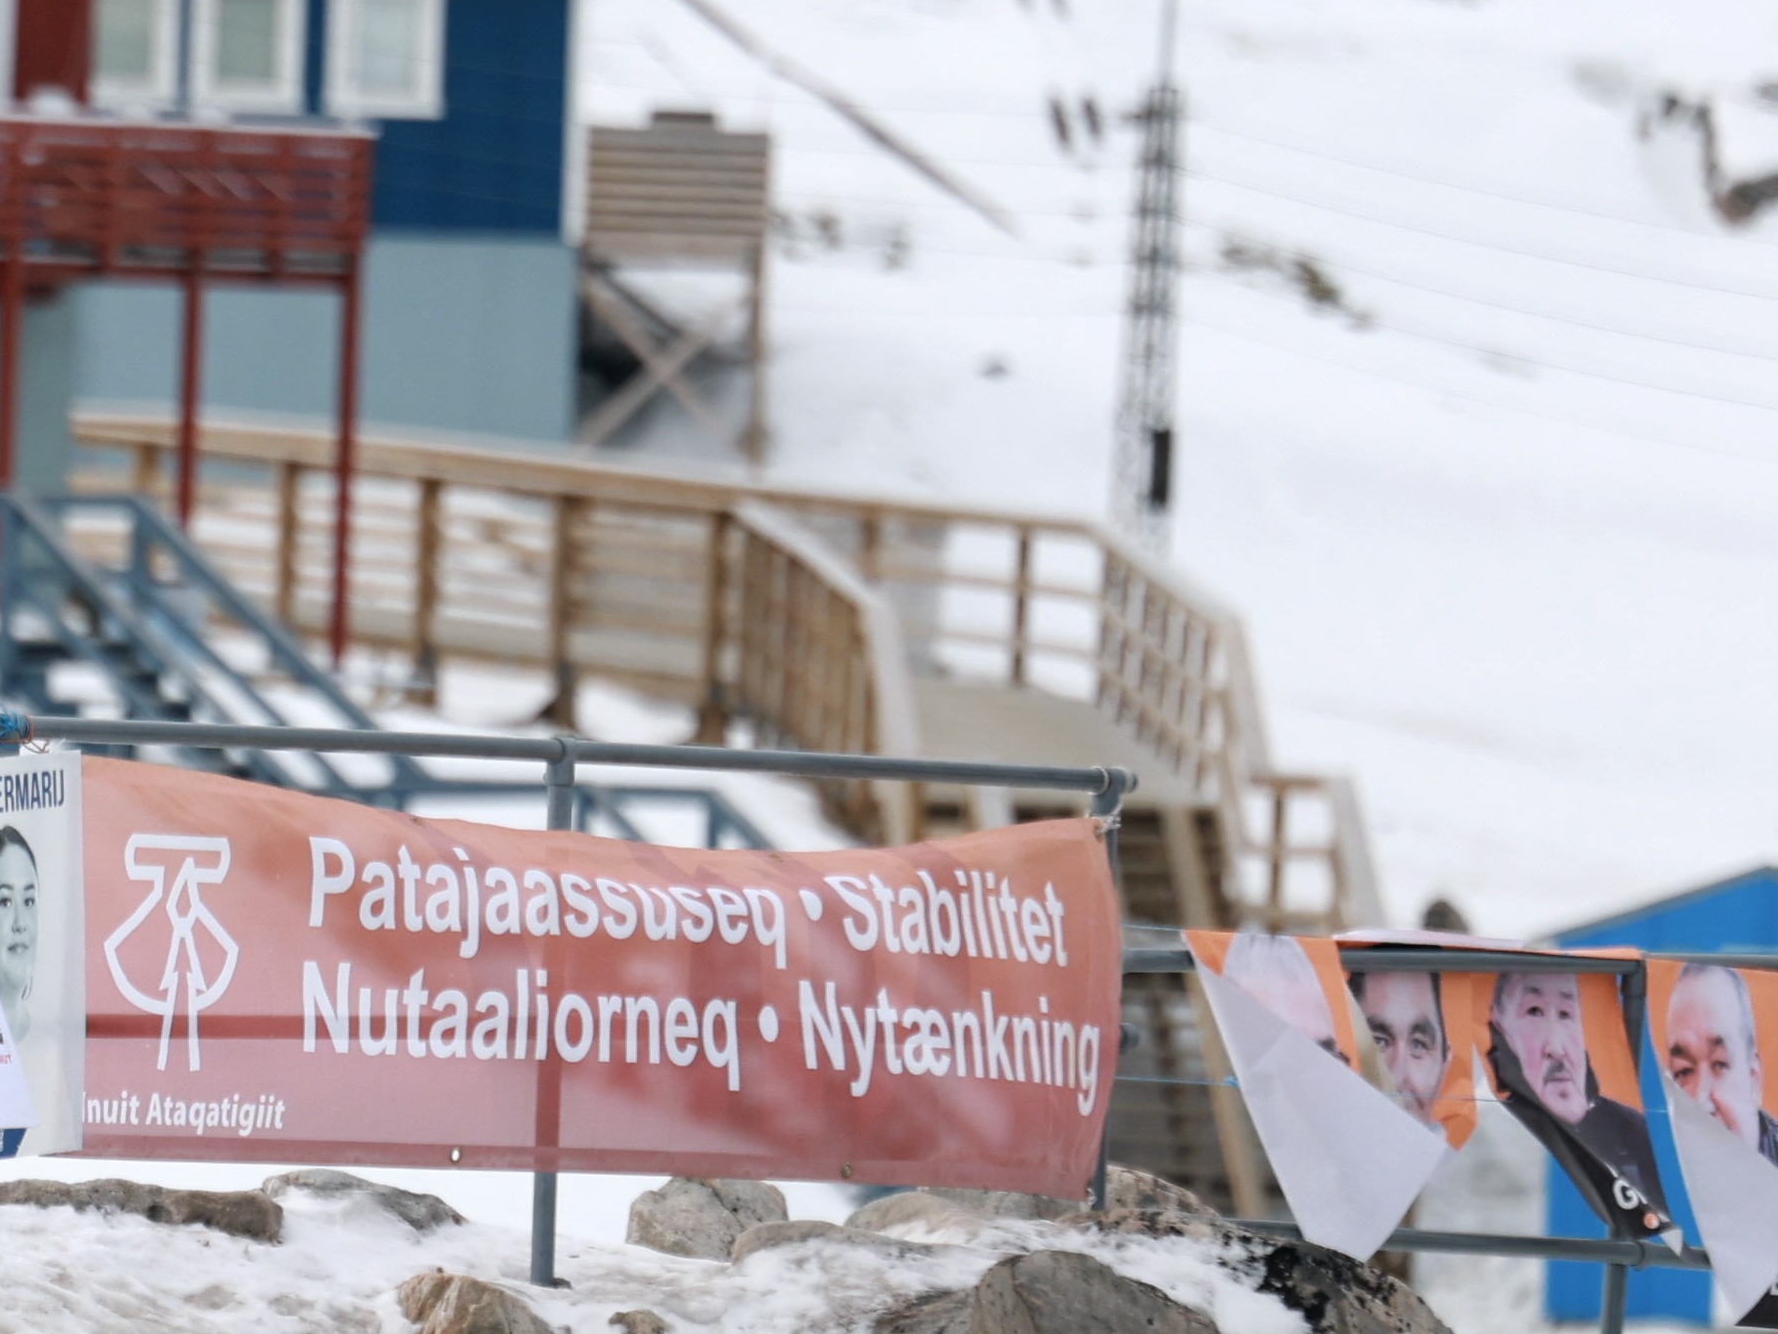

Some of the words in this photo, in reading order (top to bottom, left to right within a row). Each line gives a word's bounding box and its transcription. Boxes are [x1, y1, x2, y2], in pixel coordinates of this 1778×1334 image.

[308, 836, 787, 969] Patajaassuseq
[824, 867, 1068, 968] Stabilitet
[301, 960, 740, 1091] Nutaaliorneq
[798, 979, 1100, 1117] Nytænkning
[145, 1093, 285, 1137] Ataqatigiit
